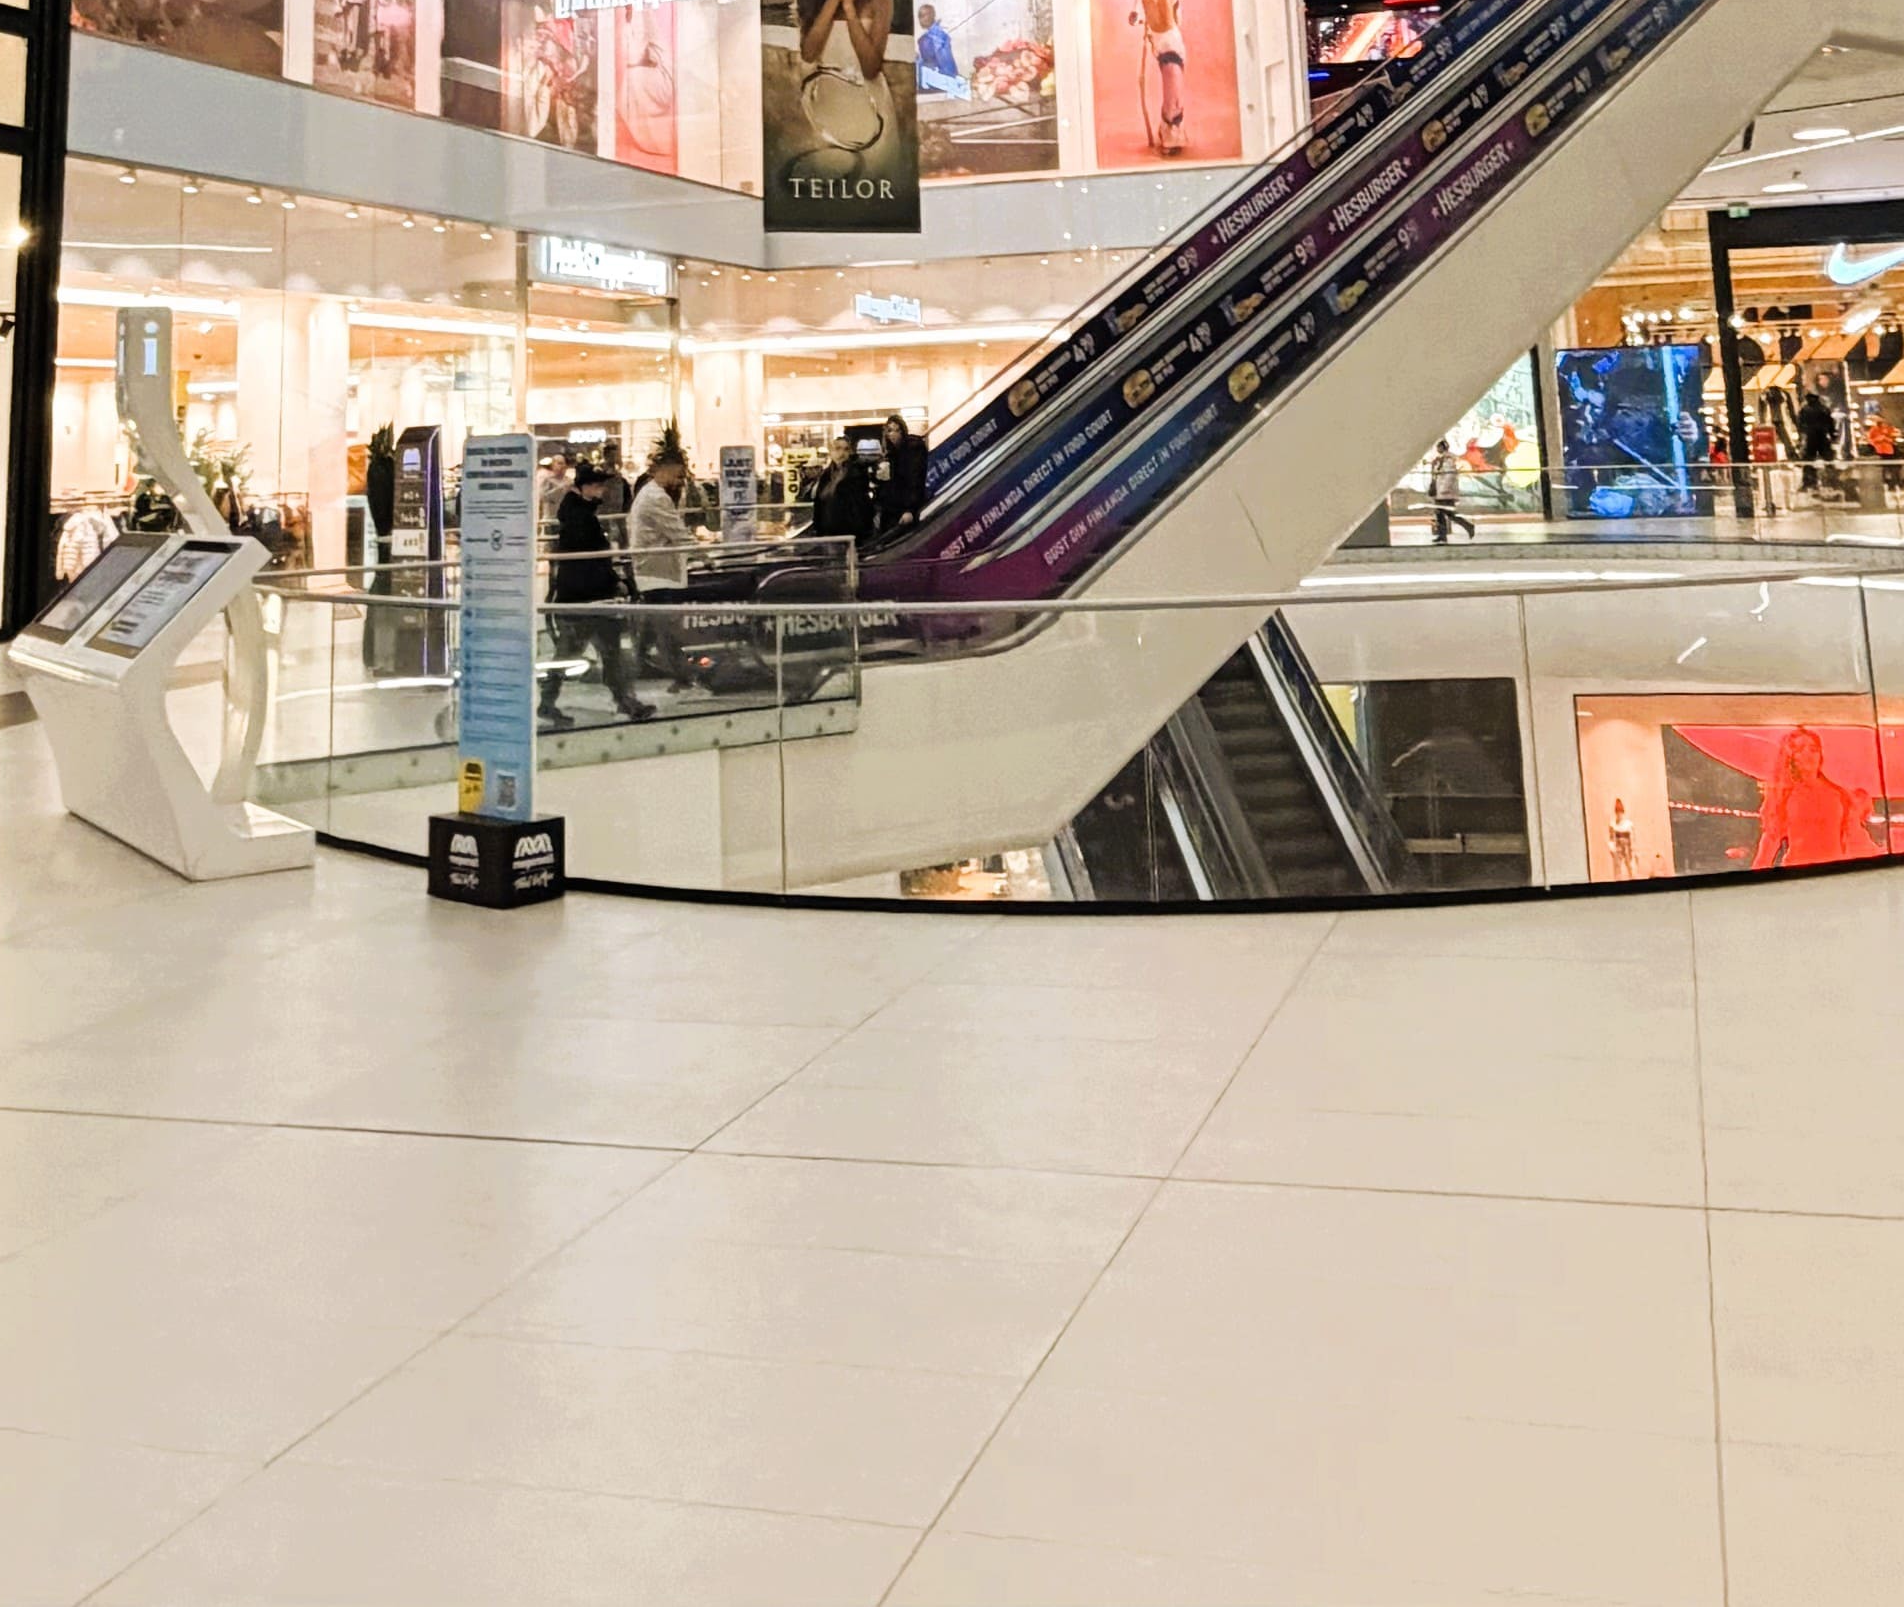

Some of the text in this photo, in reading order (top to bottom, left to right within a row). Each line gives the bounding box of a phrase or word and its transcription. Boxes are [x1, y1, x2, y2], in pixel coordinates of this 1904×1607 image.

[789, 178, 895, 199] TEILOR
[1215, 174, 1293, 244] HESBURGER
[1333, 160, 1408, 231] HESBURGER
[1436, 143, 1512, 216] HESBURGER
[780, 600, 899, 637] HESBUGER
